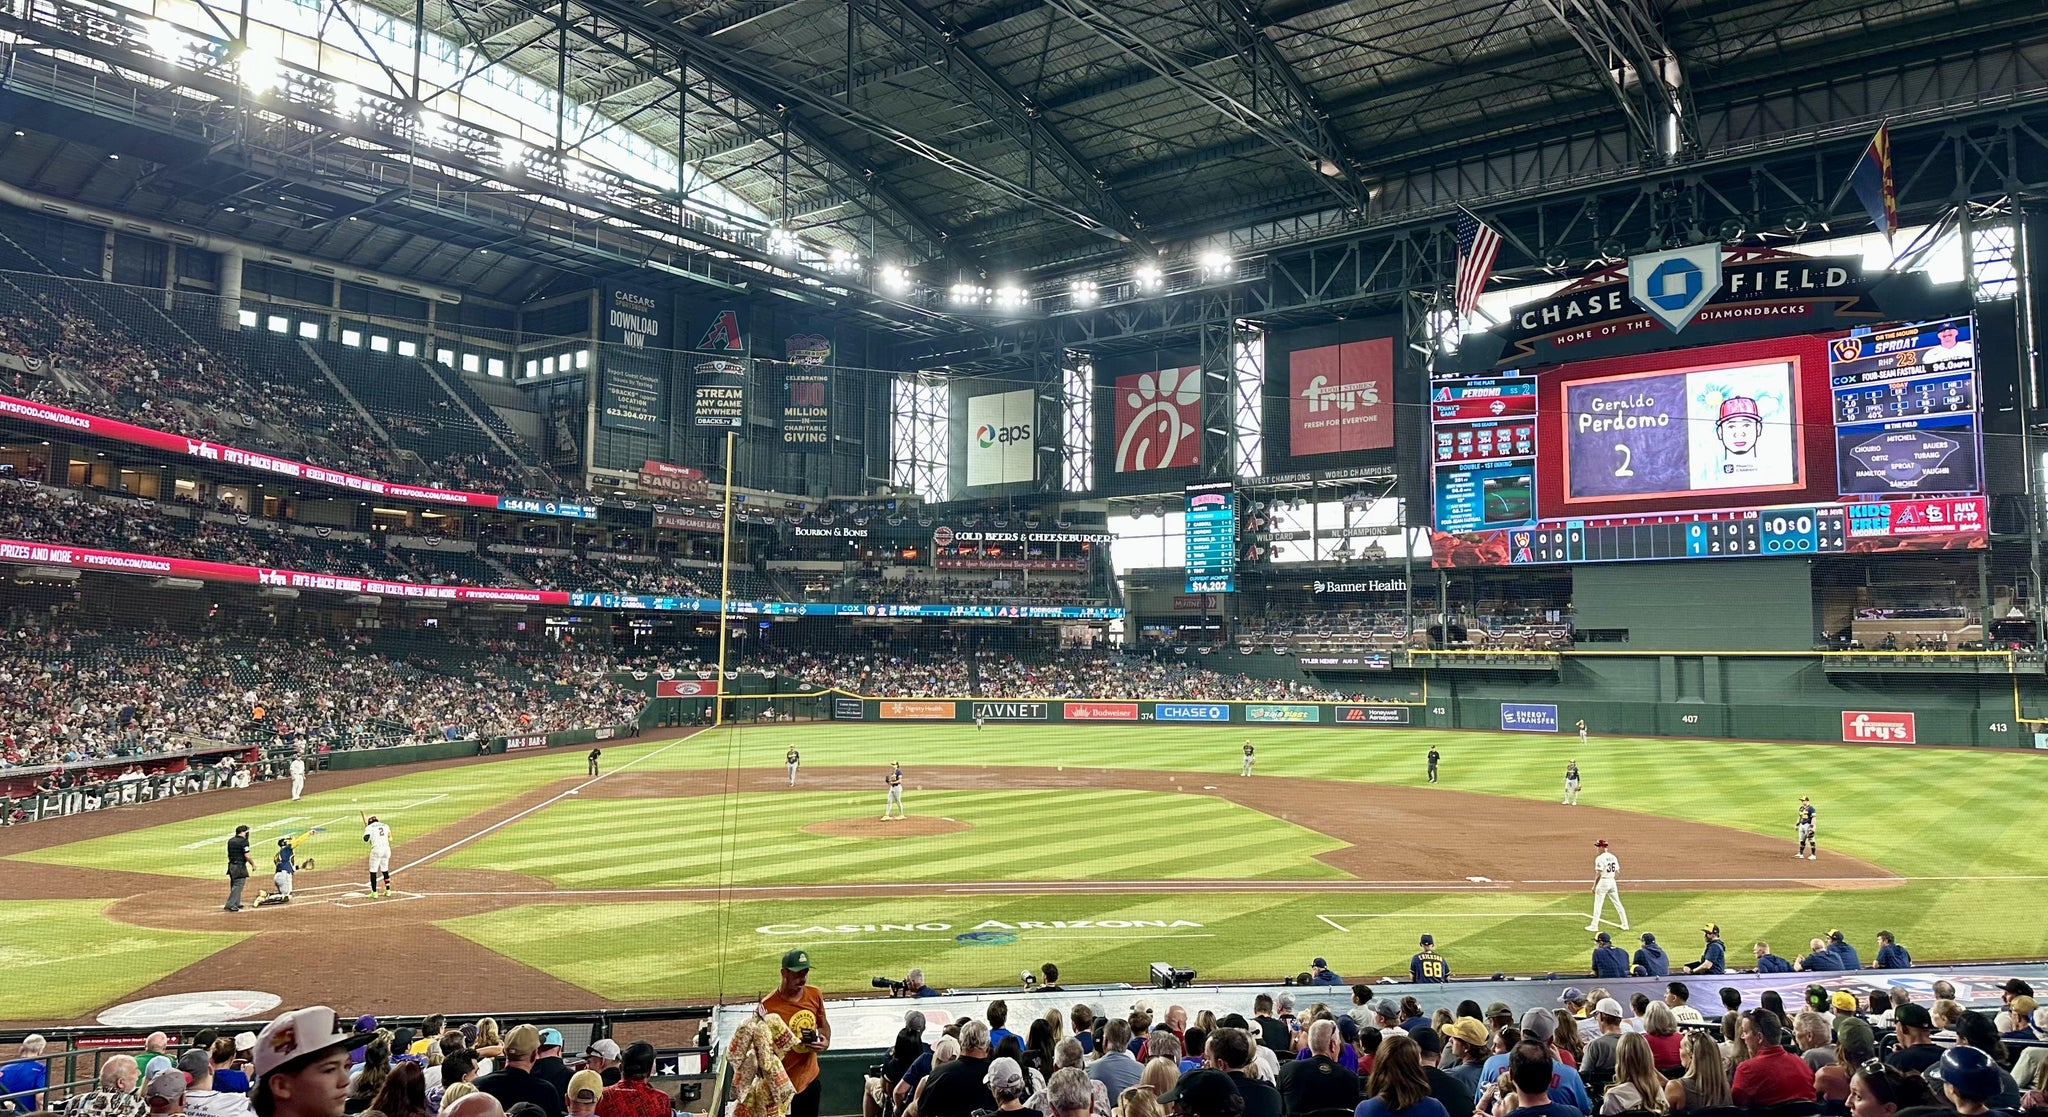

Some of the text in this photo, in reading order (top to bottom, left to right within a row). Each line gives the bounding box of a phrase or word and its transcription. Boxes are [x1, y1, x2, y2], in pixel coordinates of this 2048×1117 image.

[615, 290, 655, 308] CAESARS
[1520, 267, 1847, 330] CHASE FIELD
[610, 309, 658, 336] DOWNLOAD
[1557, 305, 1805, 344] HOME OF THE DIAMONDBACKS
[624, 330, 645, 350] NOW
[1885, 329, 1919, 340] THE MOUND
[1874, 337, 1920, 354] SPROAT
[1878, 351, 1916, 367] RHP 23
[1833, 375, 1857, 385] COX
[1862, 368, 1897, 382] FOUR-SEAM
[1897, 365, 1927, 377] FASTBALL
[1320, 382, 1374, 393] FOOD STORES
[1461, 388, 1501, 398] PERDOMO
[696, 389, 743, 398] STREAM
[1301, 375, 1379, 413] fry's
[617, 396, 647, 407] LOCATION
[1591, 393, 1655, 412] Geraldo
[606, 408, 657, 422] 623.304.0777
[696, 408, 742, 416] ANYWHERE
[784, 408, 828, 416] MILLION
[1304, 415, 1378, 429] FRESH FOR EVERYONE
[1579, 412, 1669, 434] Perdomo
[784, 433, 827, 443] GIVING
[998, 424, 1030, 446] aps
[1854, 445, 1881, 453] CHOURIO
[1923, 441, 1948, 449] BAUERS
[1614, 443, 1634, 477] 2
[659, 465, 689, 475] Honeywell
[1890, 462, 1915, 470] SPROAT
[1922, 467, 1950, 475] VAUGHN
[224, 449, 243, 464] FRY'S
[272, 460, 299, 476] REWARDS
[390, 488, 468, 502] FRYSFOOD.COM/DBACKS
[1325, 466, 1392, 479] WORLD CHAMPIONS
[1251, 473, 1310, 484] WEST CHAMPIONS
[642, 475, 707, 494] SANDLOT
[504, 499, 540, 512] 1:54 PM
[1850, 504, 1891, 518] KIDS
[1953, 502, 1976, 512] JULY
[1743, 511, 1757, 519] LOB
[1953, 511, 1979, 522] 17-19
[665, 517, 705, 527] ALL-YOU-CAN-EAT
[1691, 516, 1811, 537] 0 0 0
[1851, 518, 1890, 530] FREE
[1331, 526, 1388, 537] NL CHAMPIONS
[955, 532, 1119, 543] COLD BEERS CHEESEBURGERS
[1256, 533, 1294, 542] WILD CARD
[1820, 537, 1842, 547] 2 4
[0, 544, 171, 571] PRIZES AND MORE FRYSFOOD.COM/DBACKS
[1192, 582, 1227, 592] $14,202
[1326, 579, 1407, 592] Banner Health
[424, 587, 437, 597] AND
[465, 591, 540, 601] FRYSFOOD.COM/DBACKS
[905, 705, 924, 713] Dignity
[980, 704, 1040, 717] AVNET
[1092, 708, 1131, 717] Budweiser
[1164, 707, 1207, 717] CHASE
[1432, 707, 1445, 715] 413
[1141, 712, 1154, 720] 374
[1517, 717, 1555, 725] TRANSFER
[1681, 715, 1698, 724] 407
[1849, 714, 1908, 740] fry's
[1989, 723, 2008, 732] 413
[507, 736, 547, 748] BAR-S BAR-S
[1606, 862, 1616, 873] 36
[1423, 961, 1442, 977] 68
